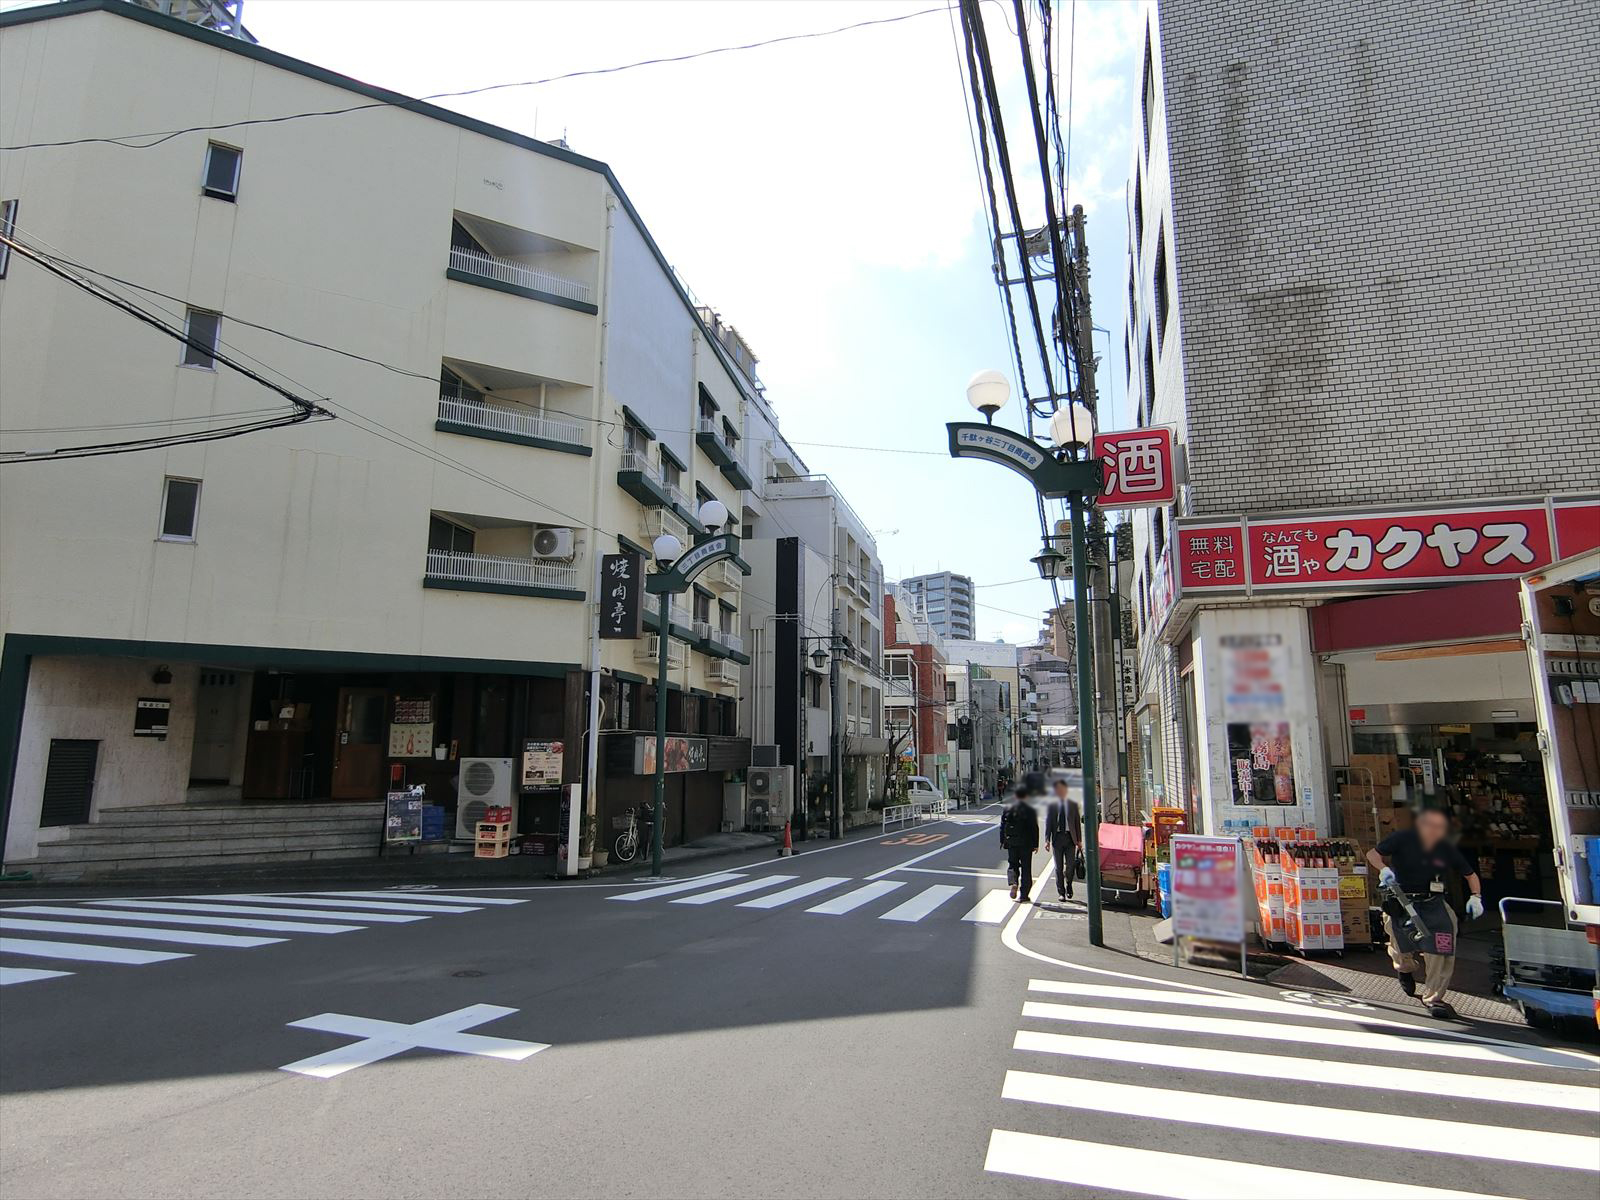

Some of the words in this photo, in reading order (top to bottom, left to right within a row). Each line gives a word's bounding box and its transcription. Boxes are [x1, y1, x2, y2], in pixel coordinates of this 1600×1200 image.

[1102, 436, 1165, 496] 酒
[1189, 536, 1234, 556] 無料
[1262, 528, 1318, 543] なんでも
[1325, 521, 1535, 573] カクヤス
[1190, 558, 1236, 579] 宅配
[1264, 544, 1320, 578] 酒や
[609, 557, 631, 625] 焼肉亭
